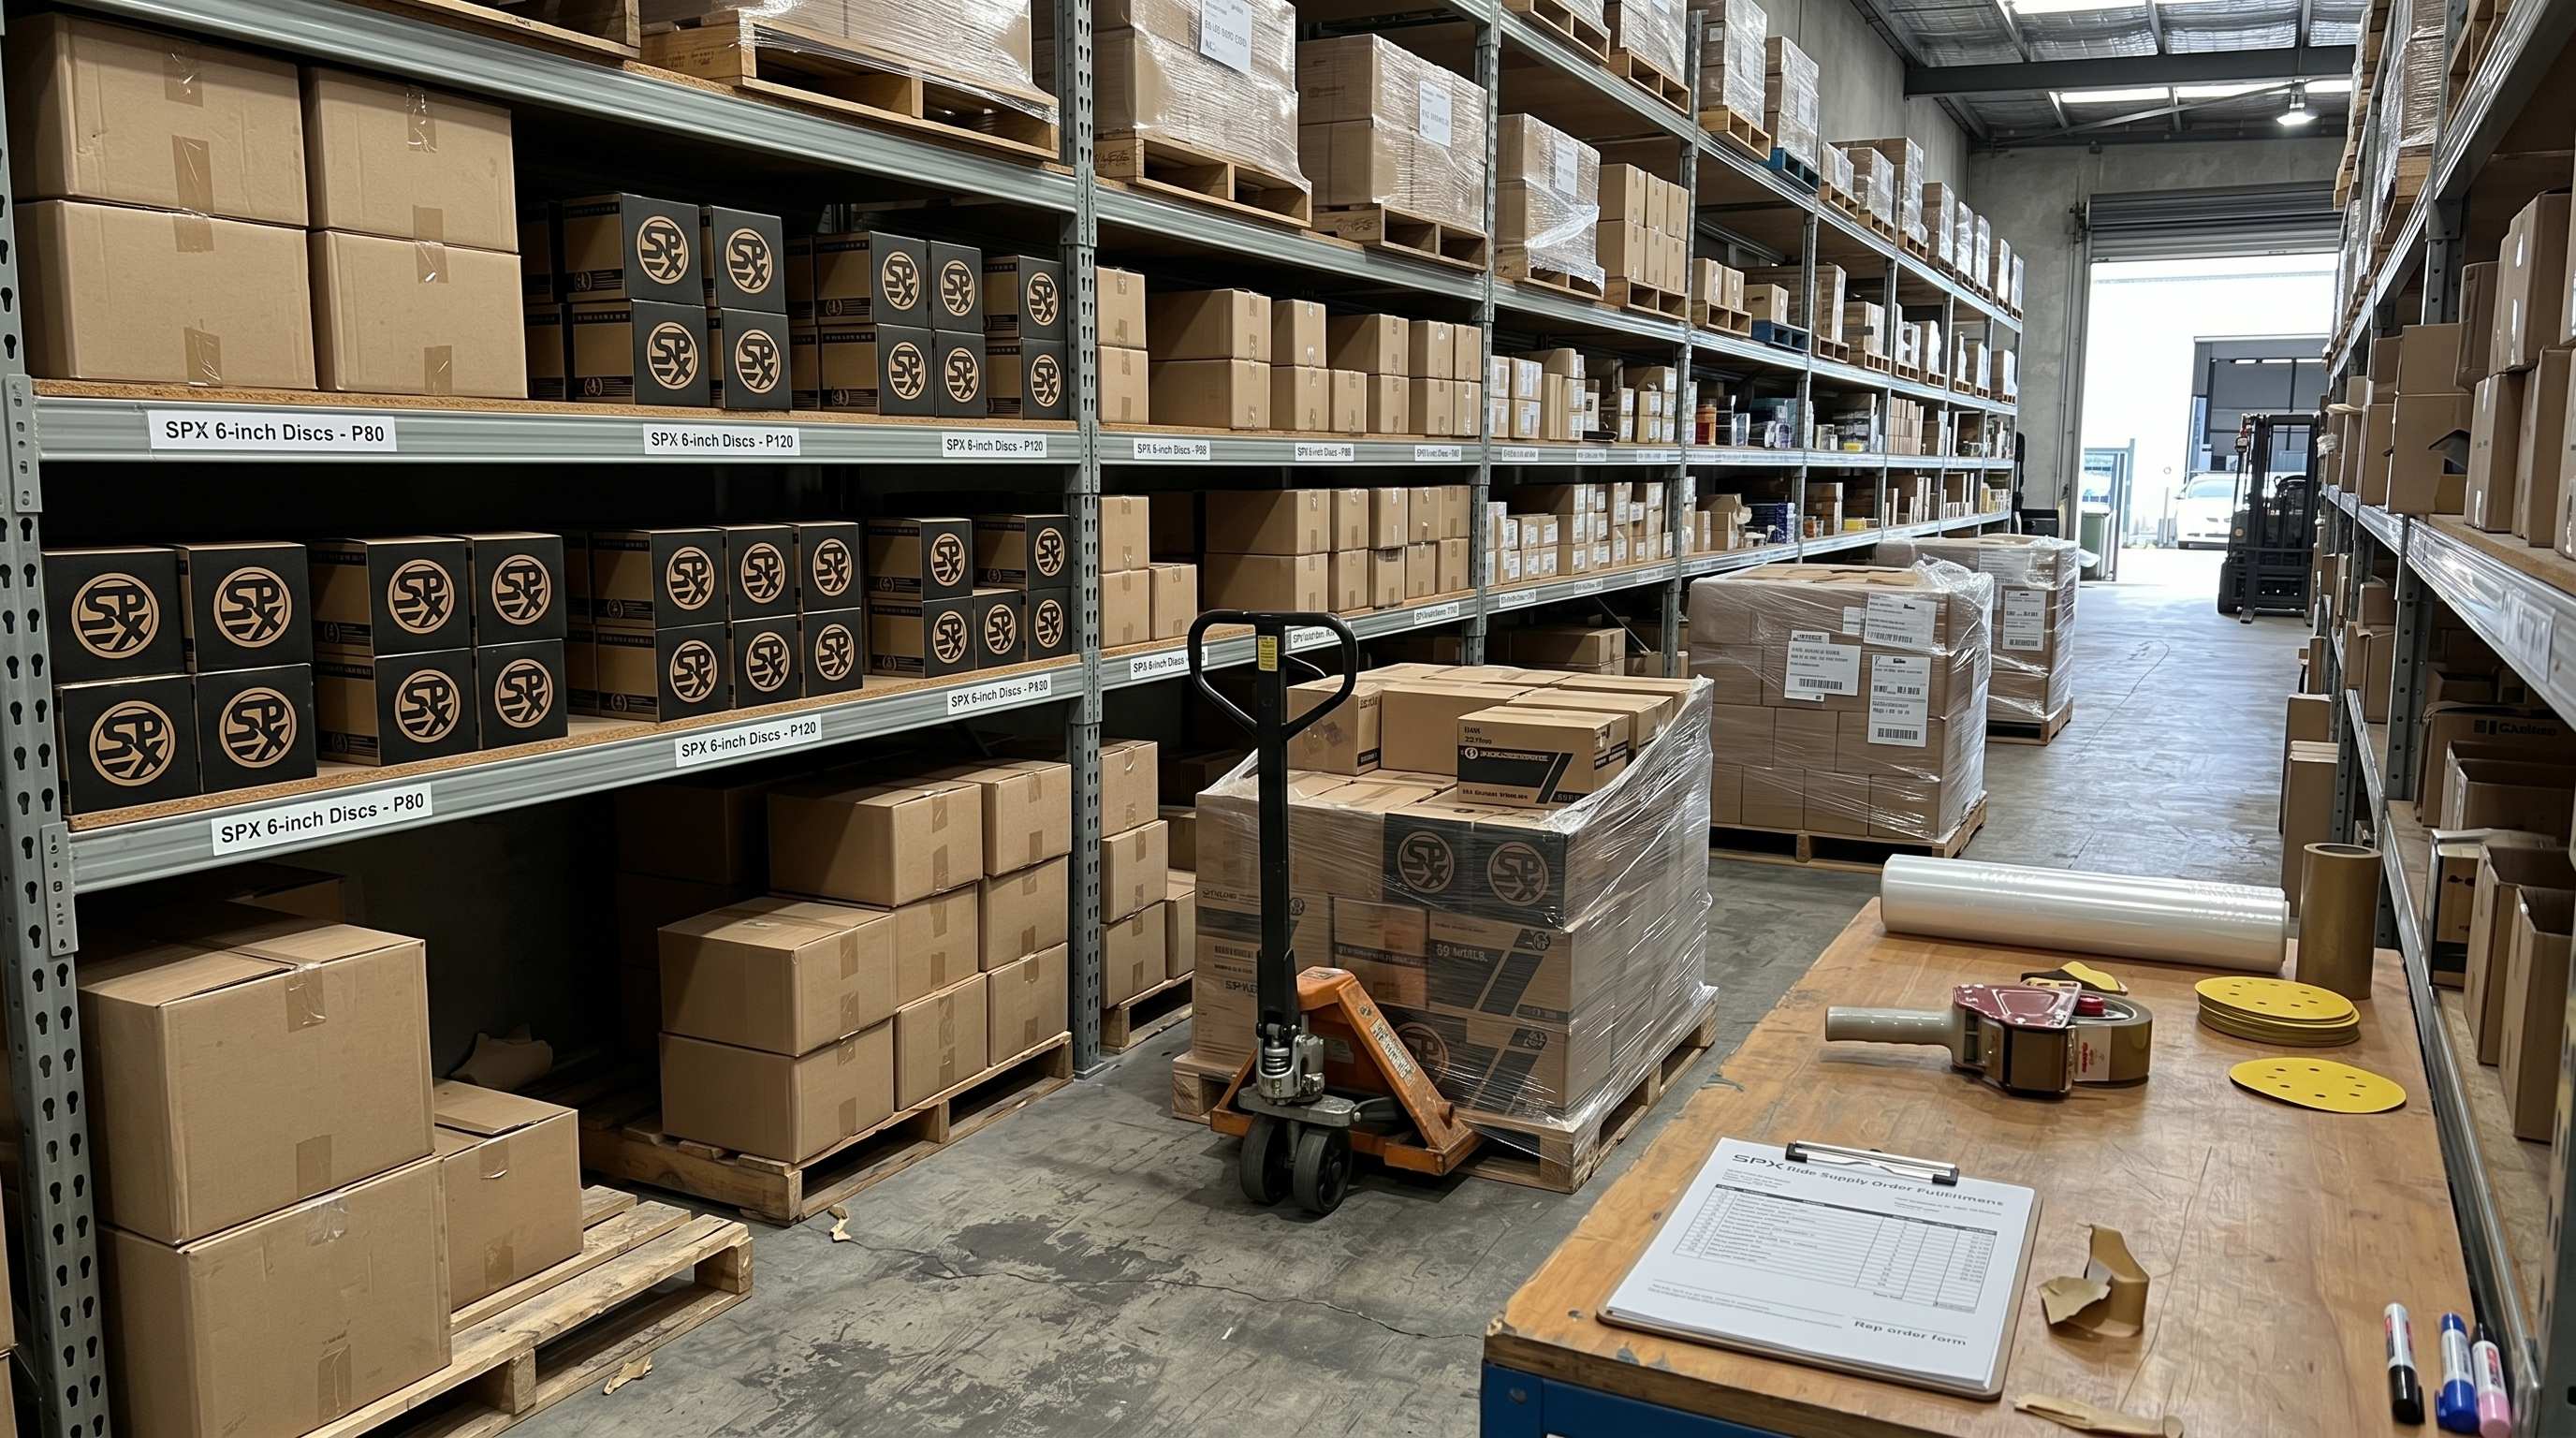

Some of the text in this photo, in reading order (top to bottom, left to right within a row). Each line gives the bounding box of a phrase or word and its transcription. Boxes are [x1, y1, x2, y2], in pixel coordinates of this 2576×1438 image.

[166, 421, 209, 440] SPX
[215, 422, 276, 441] 6-inch
[283, 424, 334, 442] Discs
[352, 425, 385, 442] P80
[651, 432, 678, 447] SPX
[681, 433, 719, 448] 6-inch
[723, 433, 755, 448] Discs
[766, 434, 793, 448] P120
[946, 438, 965, 450] SPX
[995, 440, 1017, 451] Discs
[1024, 440, 1043, 451] P120
[951, 694, 970, 708] SPX
[972, 690, 998, 703] 6-inch
[999, 686, 1022, 698] Discs
[681, 741, 708, 757] SPX
[710, 735, 746, 752] 6-inch
[750, 730, 781, 745] Discs
[790, 721, 816, 738] P120
[221, 821, 261, 843] SPX
[267, 811, 323, 835] 6-inch
[329, 804, 377, 824] Discs
[394, 792, 424, 813] P80
[1732, 1153, 1785, 1172] SPX
[1820, 1173, 1867, 1187] Supply
[1872, 1181, 1912, 1193] Order
[1854, 1320, 1967, 1345] Rep order form
